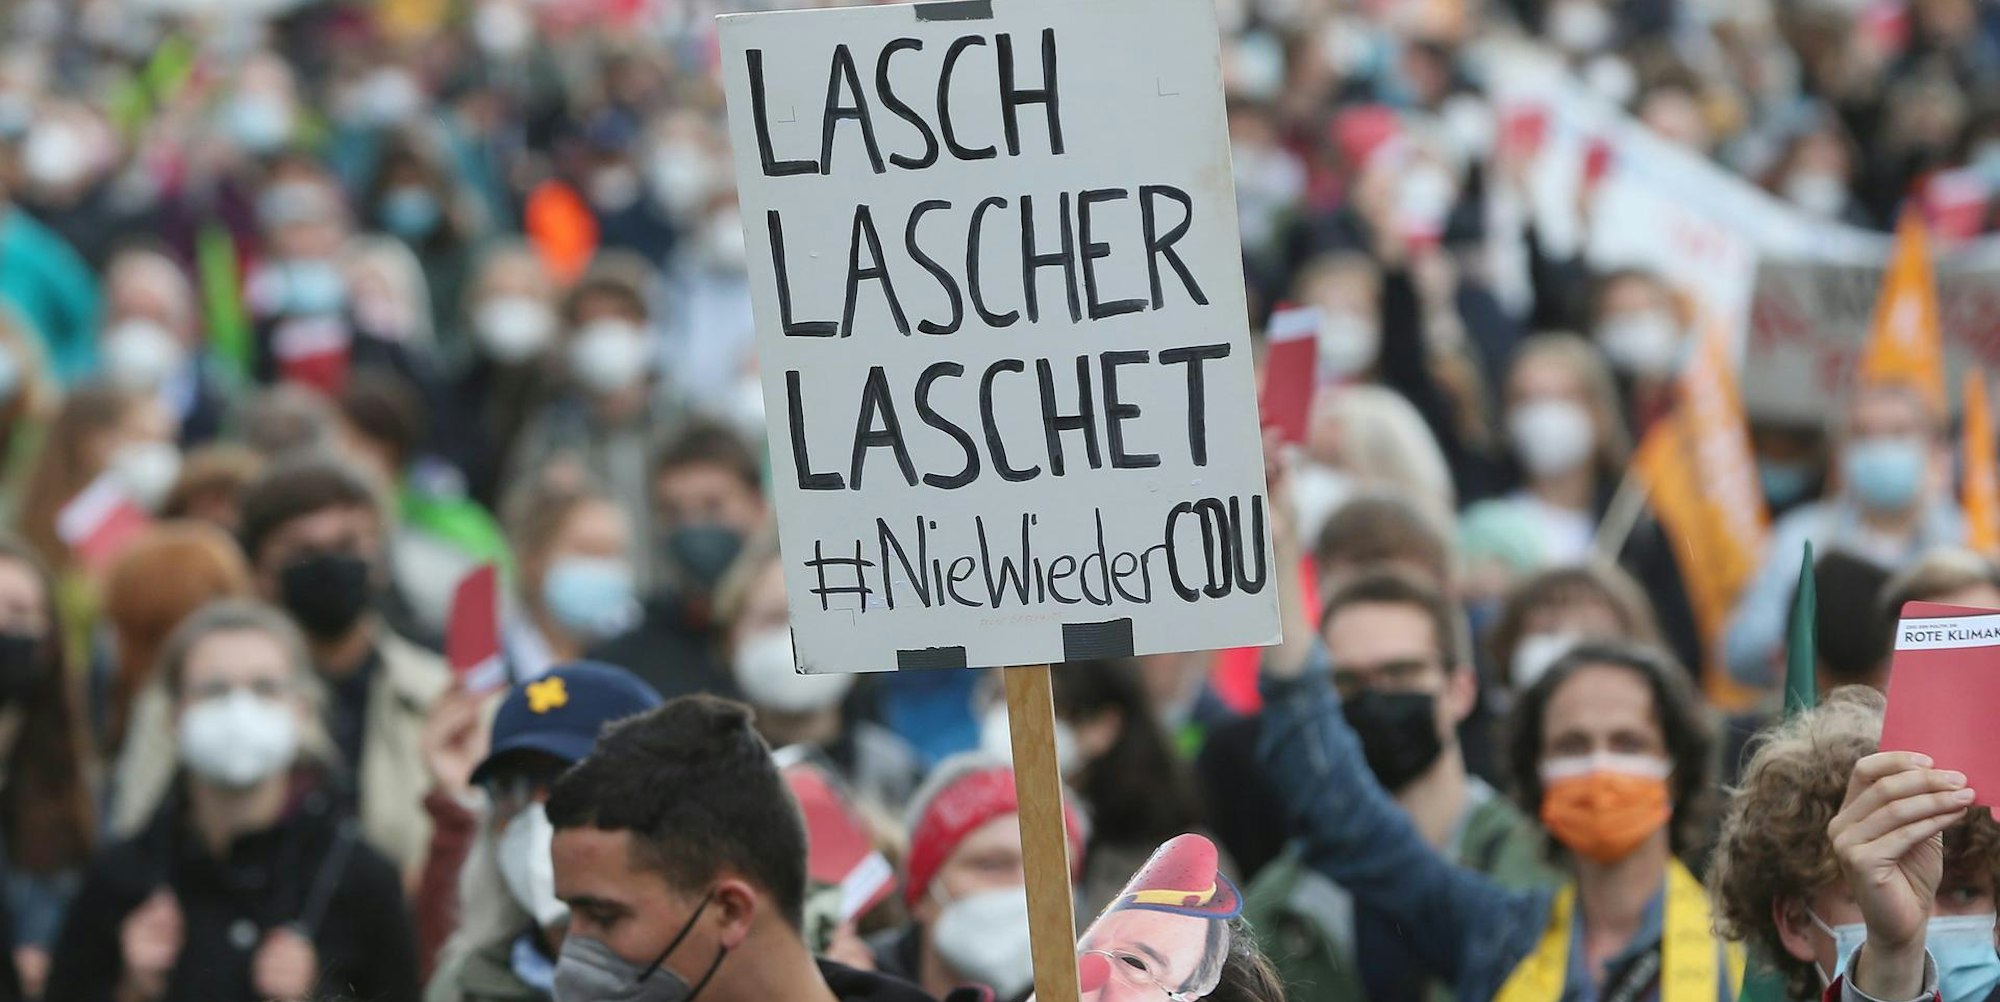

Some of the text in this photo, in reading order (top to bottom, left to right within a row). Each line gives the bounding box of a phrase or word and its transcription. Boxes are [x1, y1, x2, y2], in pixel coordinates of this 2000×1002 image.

[746, 28, 1064, 176] LASCH
[767, 185, 1210, 338] LASCHER
[785, 342, 1231, 490] LASCHET
[804, 495, 1268, 613] #NieWiederCDU
[1904, 631, 1943, 643] ROTE
